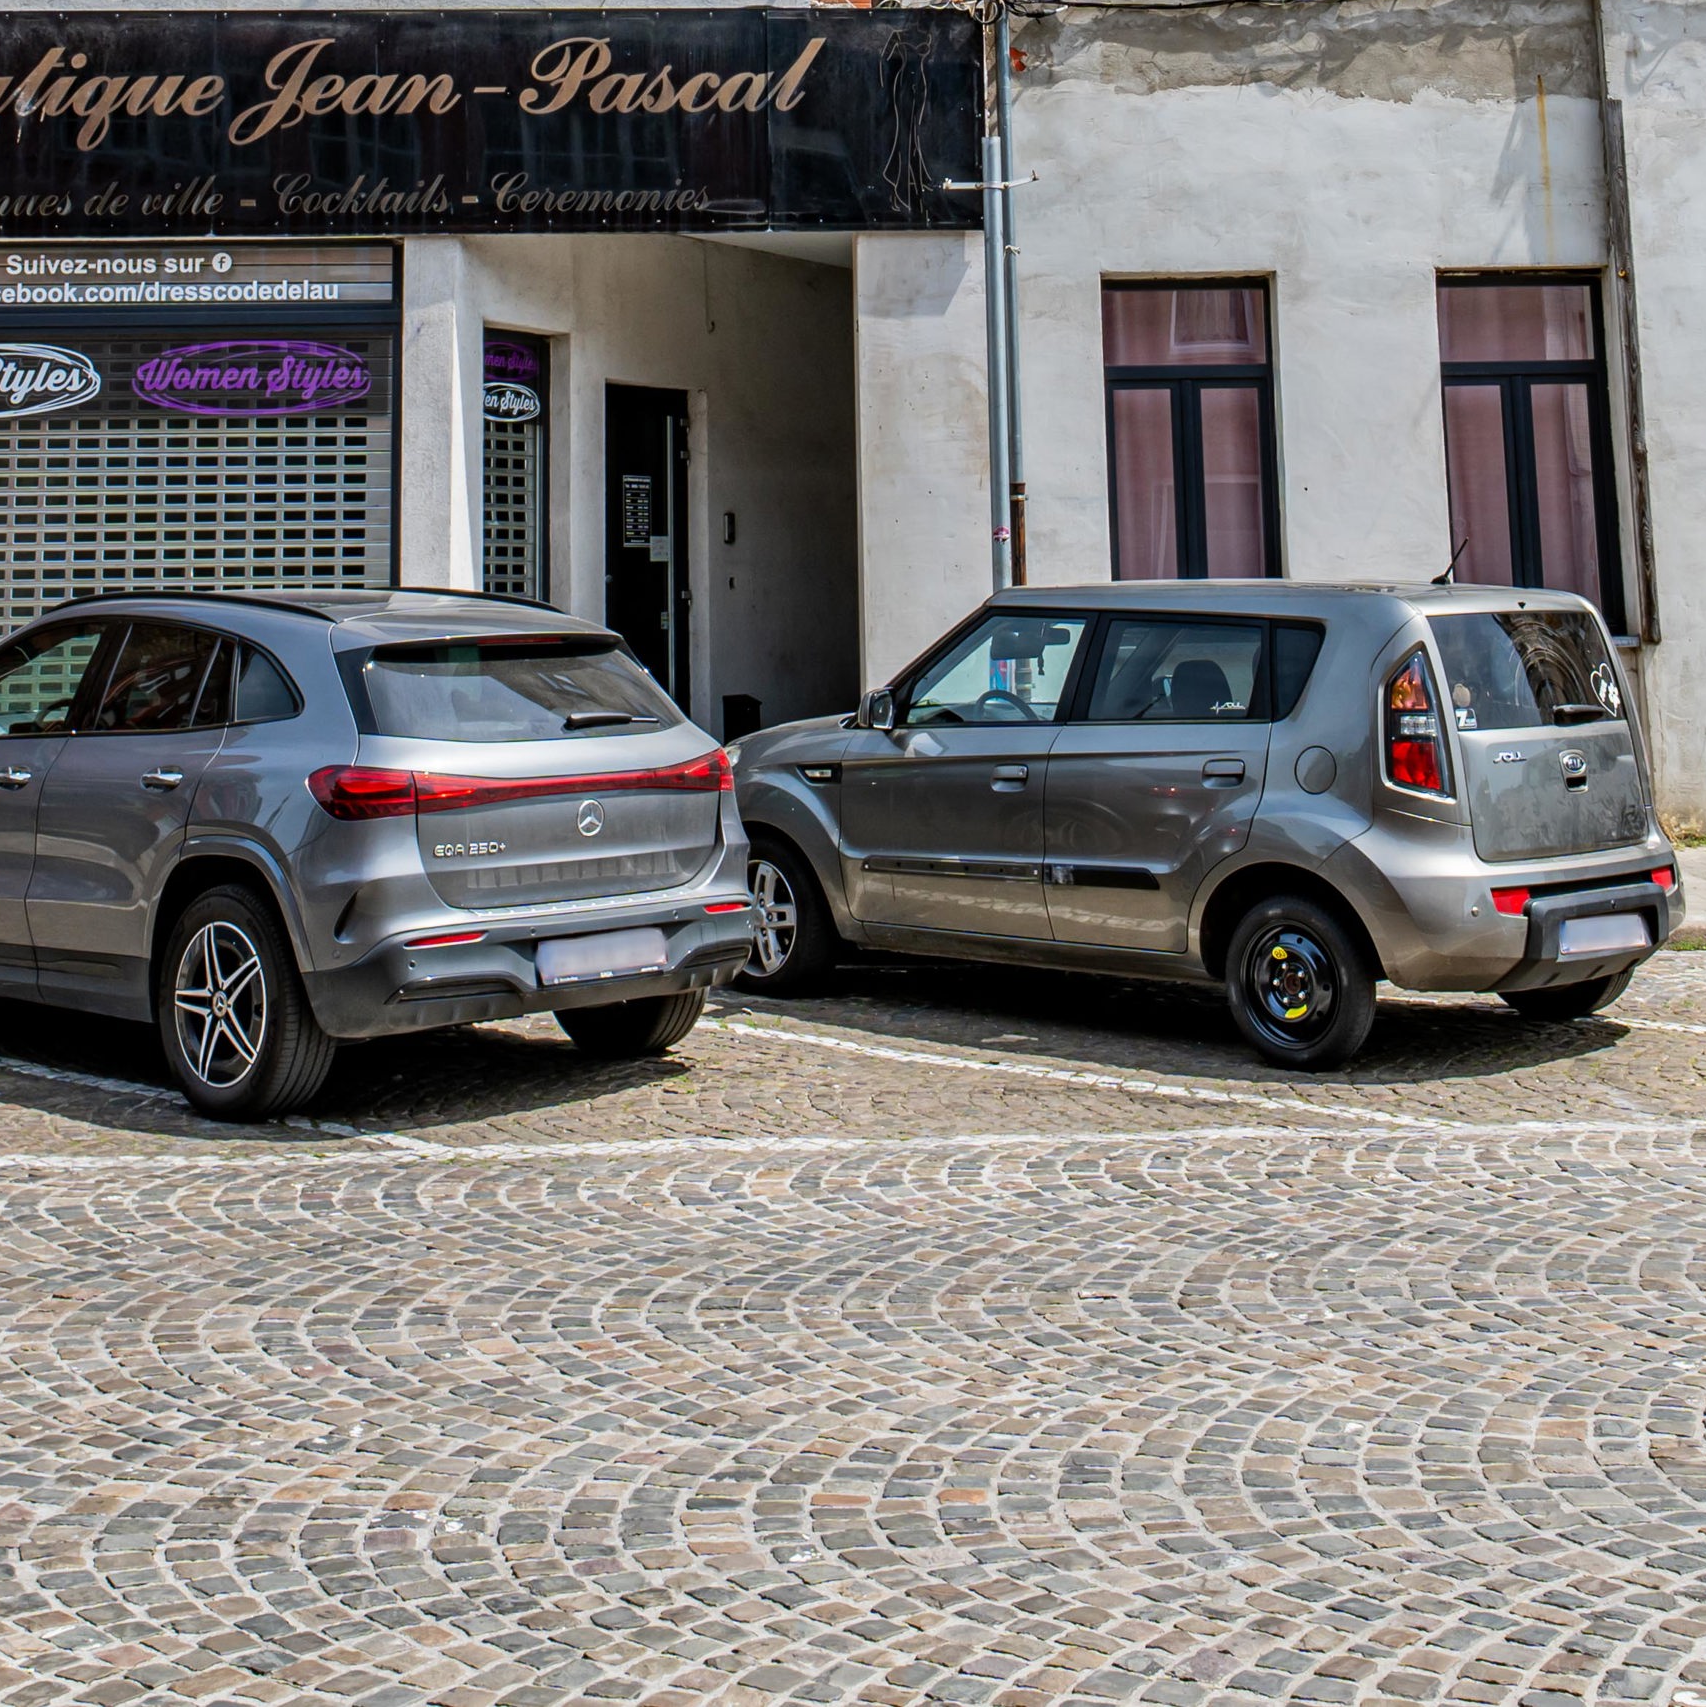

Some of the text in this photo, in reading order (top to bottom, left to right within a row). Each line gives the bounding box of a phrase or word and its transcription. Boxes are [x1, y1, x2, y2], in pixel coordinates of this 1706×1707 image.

[228, 37, 462, 145] Jean
[519, 37, 827, 115] Pascal
[84, 180, 131, 216] de
[141, 175, 224, 216] ville
[271, 172, 450, 216] Cocktails
[490, 171, 710, 213] Ceremonies
[6, 254, 159, 275] Suivez-nous
[164, 257, 205, 273] sur
[137, 355, 366, 399] Women Styles
[483, 389, 536, 415] en Styles
[434, 841, 506, 856] EQA 250+
